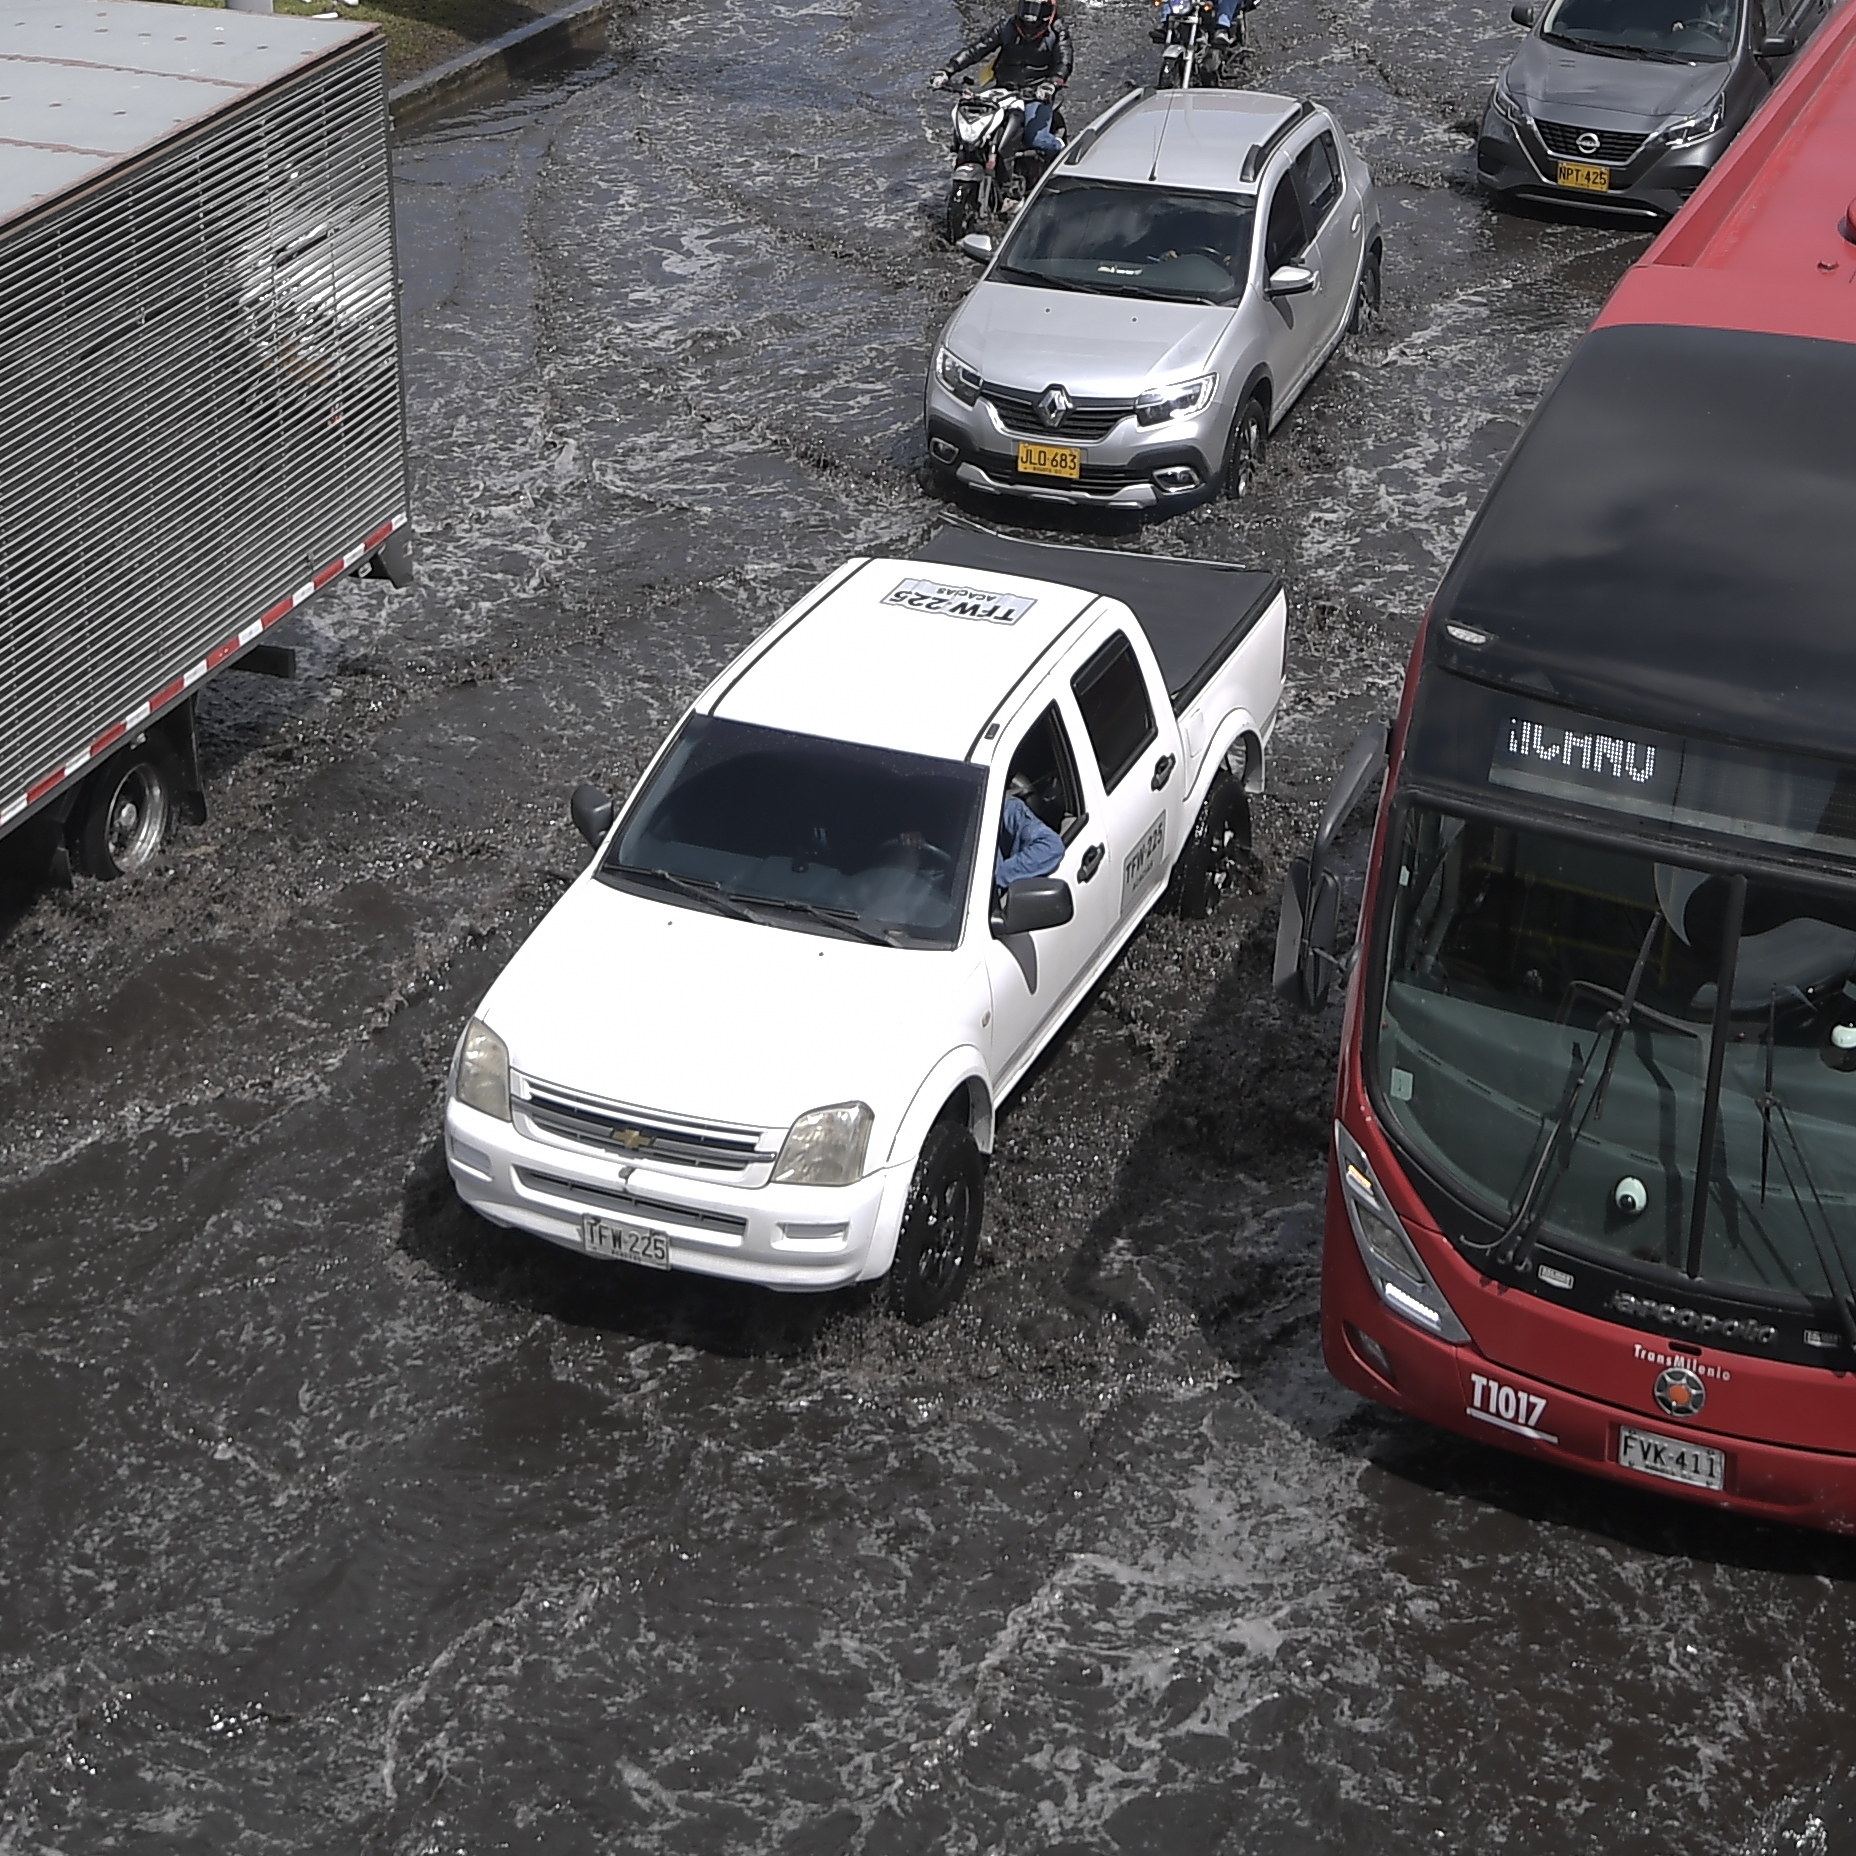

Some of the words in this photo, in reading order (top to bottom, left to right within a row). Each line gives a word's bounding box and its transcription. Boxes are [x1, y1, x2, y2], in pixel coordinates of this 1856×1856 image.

[936, 587, 997, 603] ACACIAS
[1633, 1343, 1731, 1382] TransMilenio
[1470, 1373, 1547, 1427] T1017
